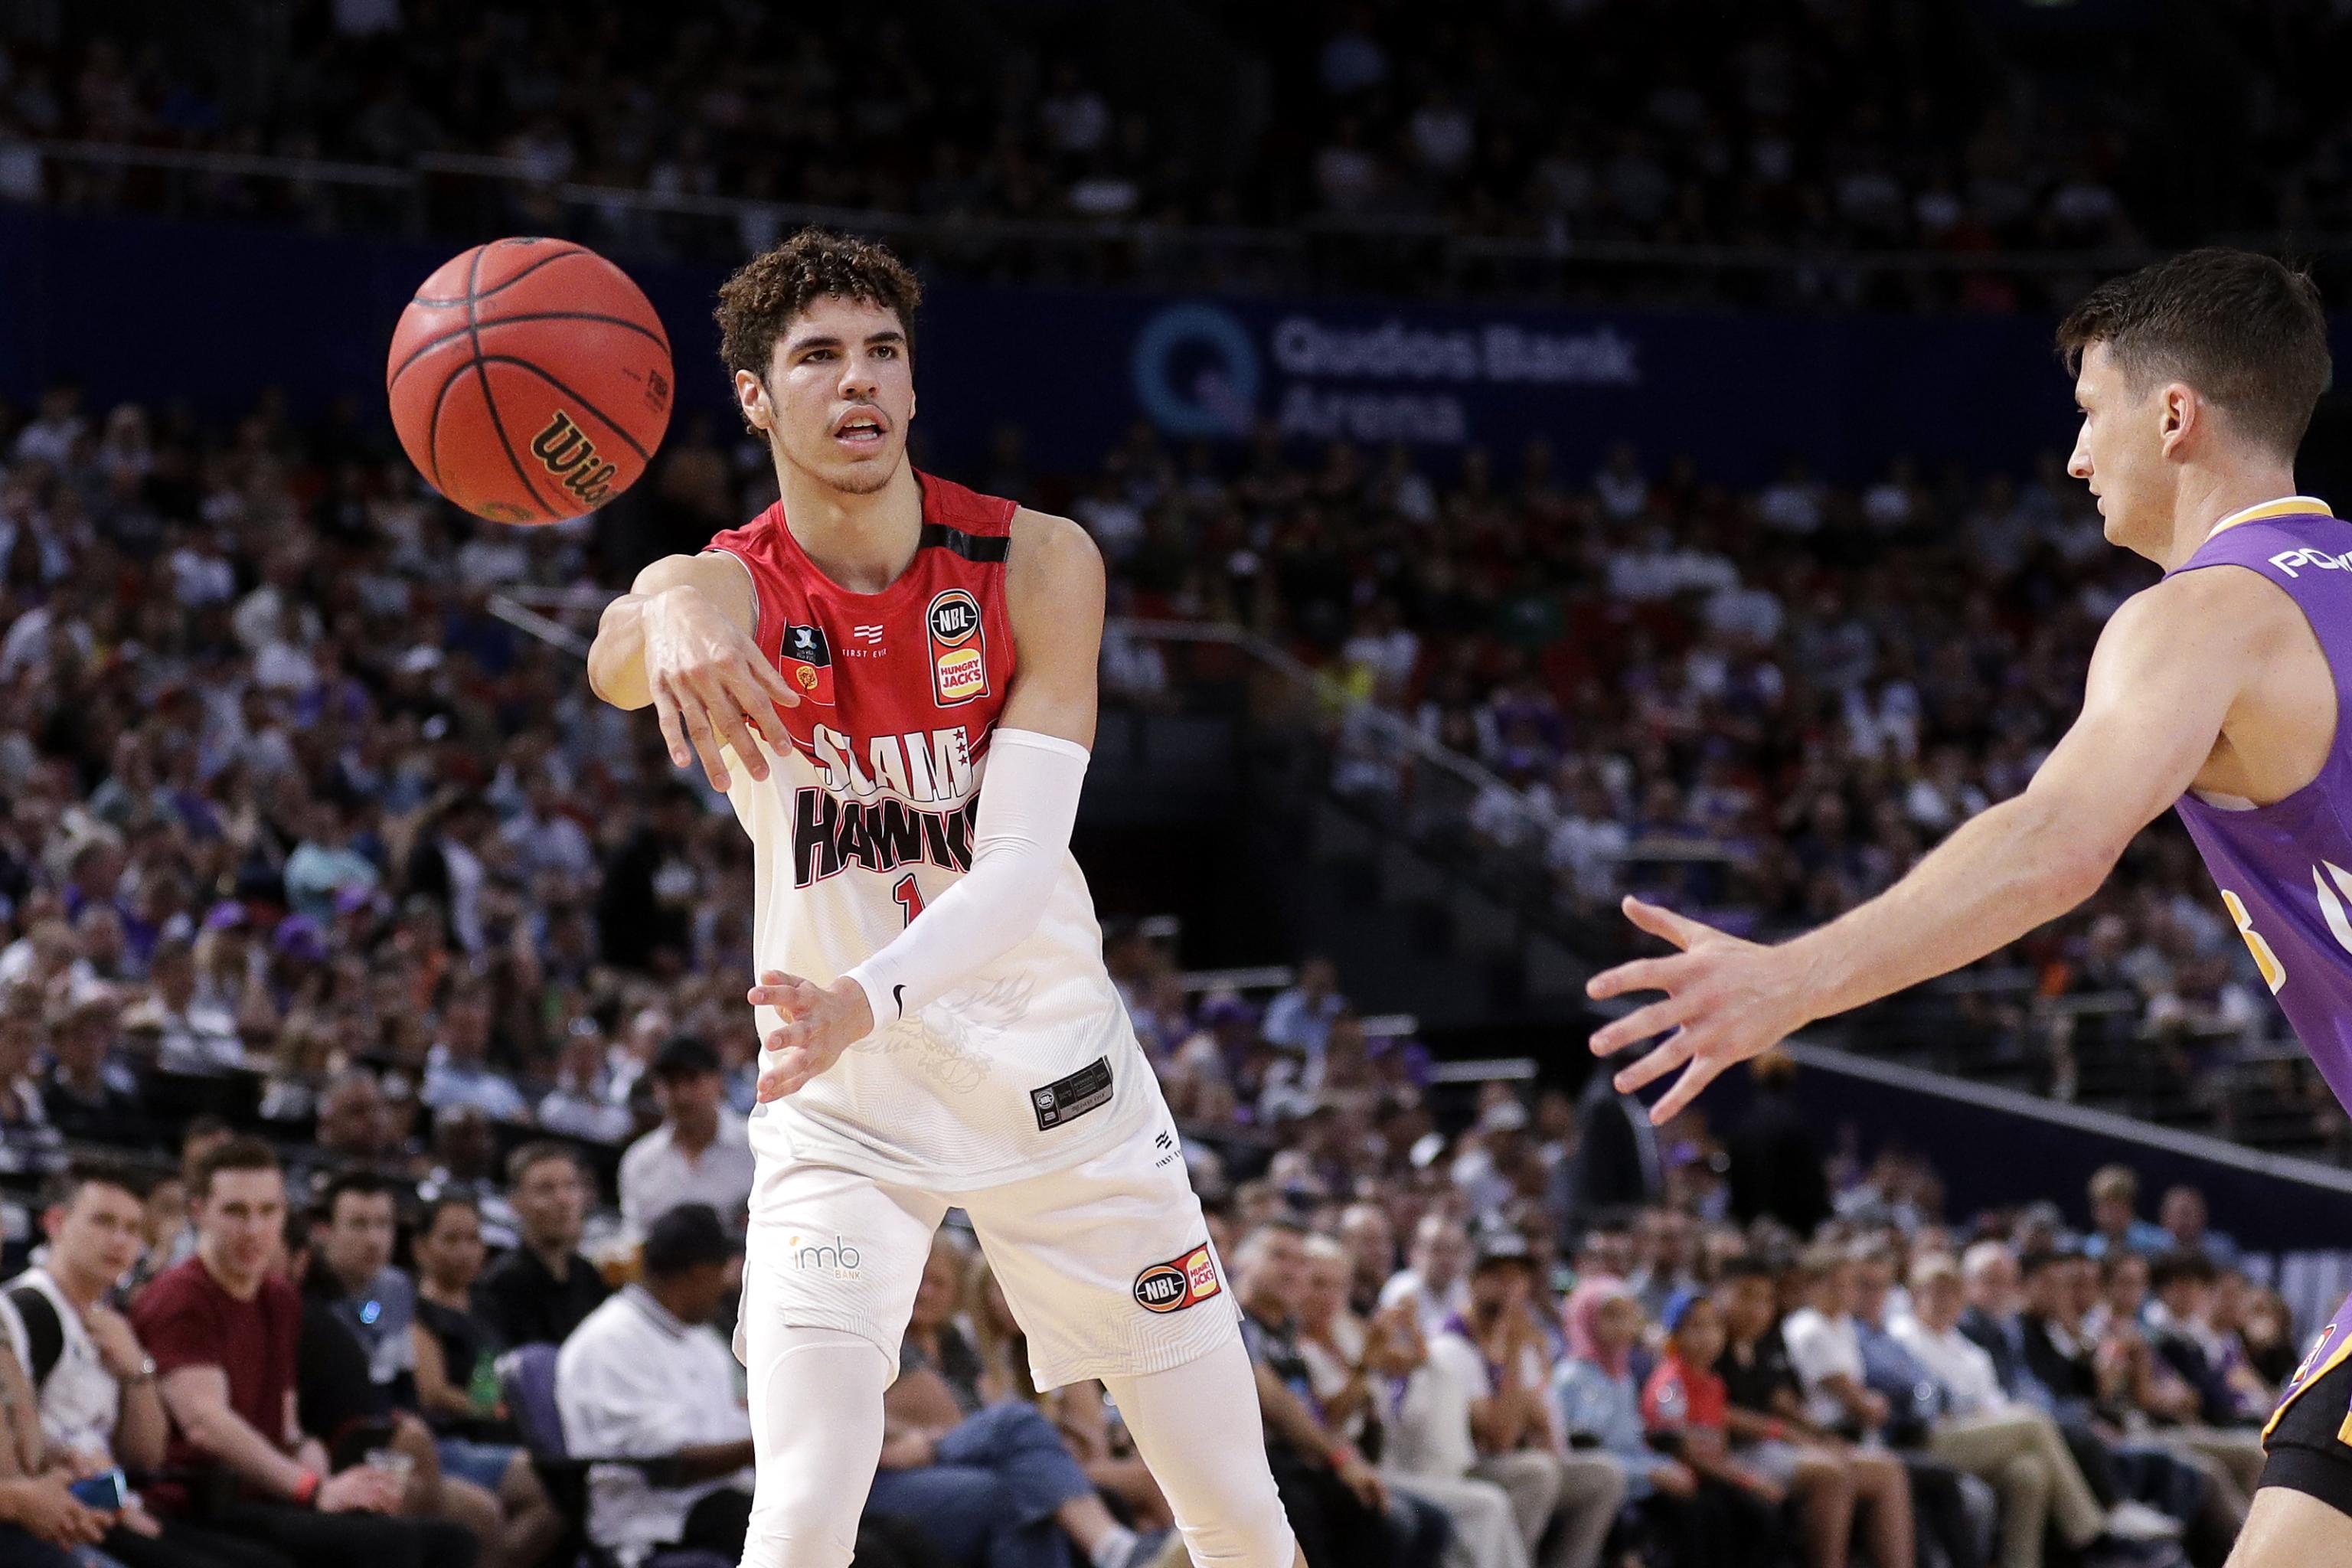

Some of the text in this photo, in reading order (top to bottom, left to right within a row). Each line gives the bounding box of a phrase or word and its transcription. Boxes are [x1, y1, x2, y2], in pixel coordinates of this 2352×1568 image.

[939, 606, 969, 632] NBL
[941, 659, 979, 675] HUNGRY
[813, 724, 973, 802] SLAM
[789, 1235, 860, 1269] imb
[835, 1269, 861, 1280] BANK
[1145, 1276, 1178, 1302] NBL
